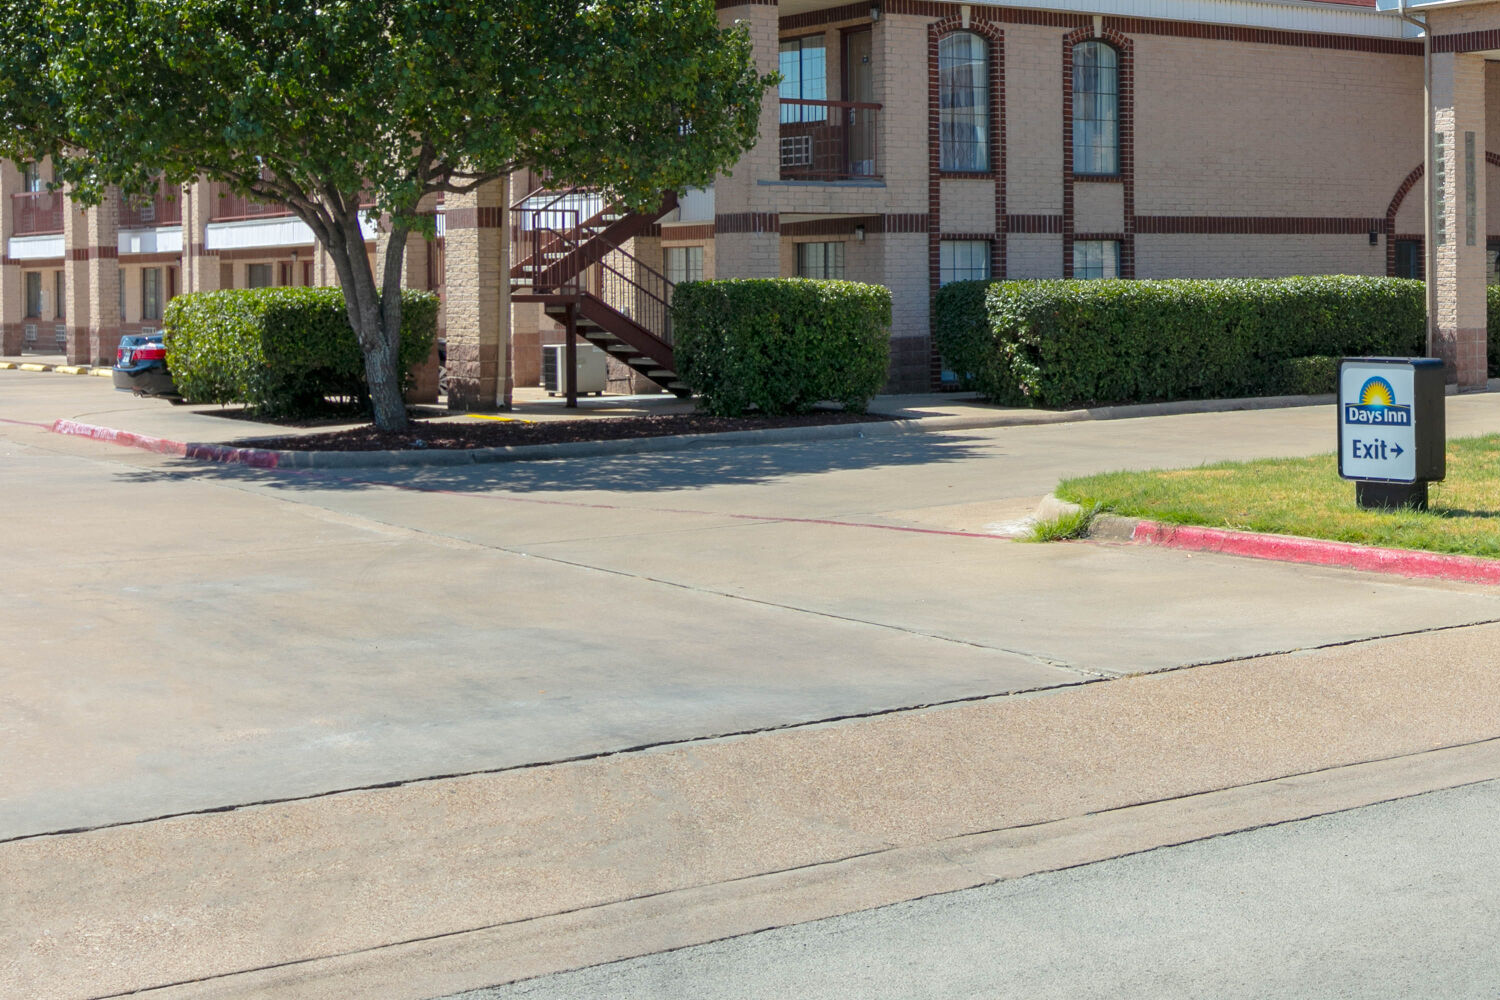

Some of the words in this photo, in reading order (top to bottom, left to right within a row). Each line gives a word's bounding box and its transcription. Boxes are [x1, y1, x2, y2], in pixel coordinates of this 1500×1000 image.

[1349, 407, 1382, 424] Days
[1384, 408, 1407, 423] Inn
[1352, 438, 1388, 460] Exit
